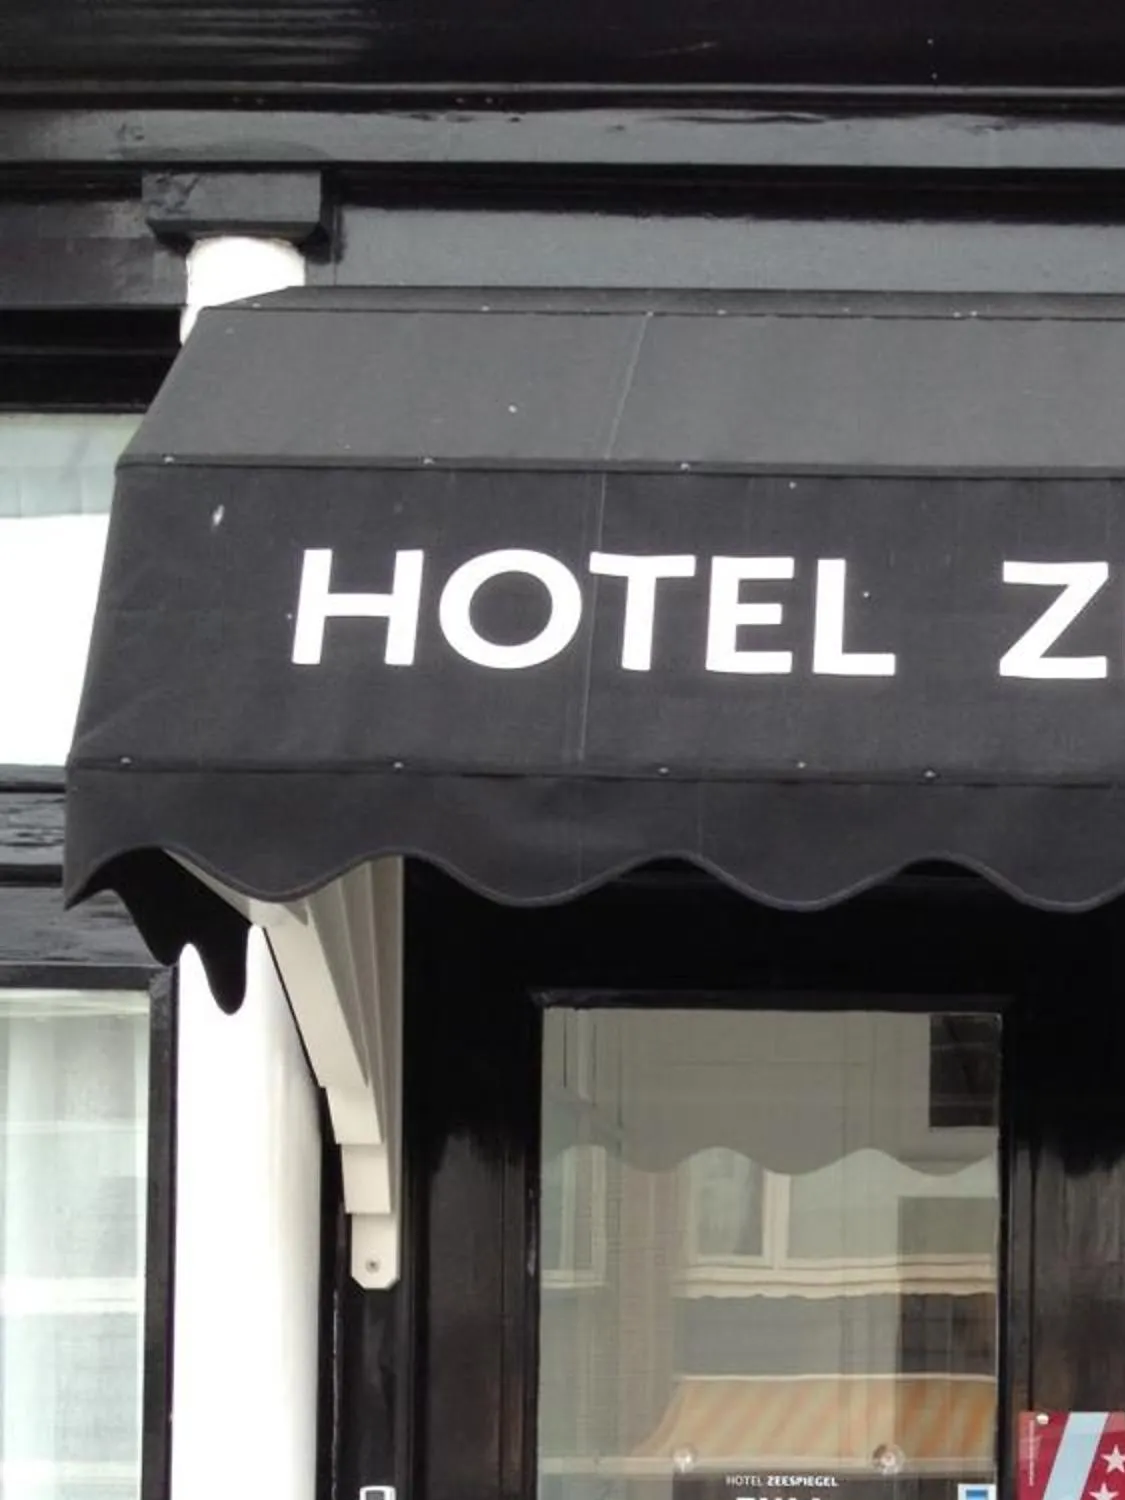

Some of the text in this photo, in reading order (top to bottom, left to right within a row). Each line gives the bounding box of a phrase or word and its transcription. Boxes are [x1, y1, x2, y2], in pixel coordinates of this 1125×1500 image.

[288, 547, 897, 678] HOTEL
[726, 1475, 838, 1487] HOTEL ZEESPIEGEL
